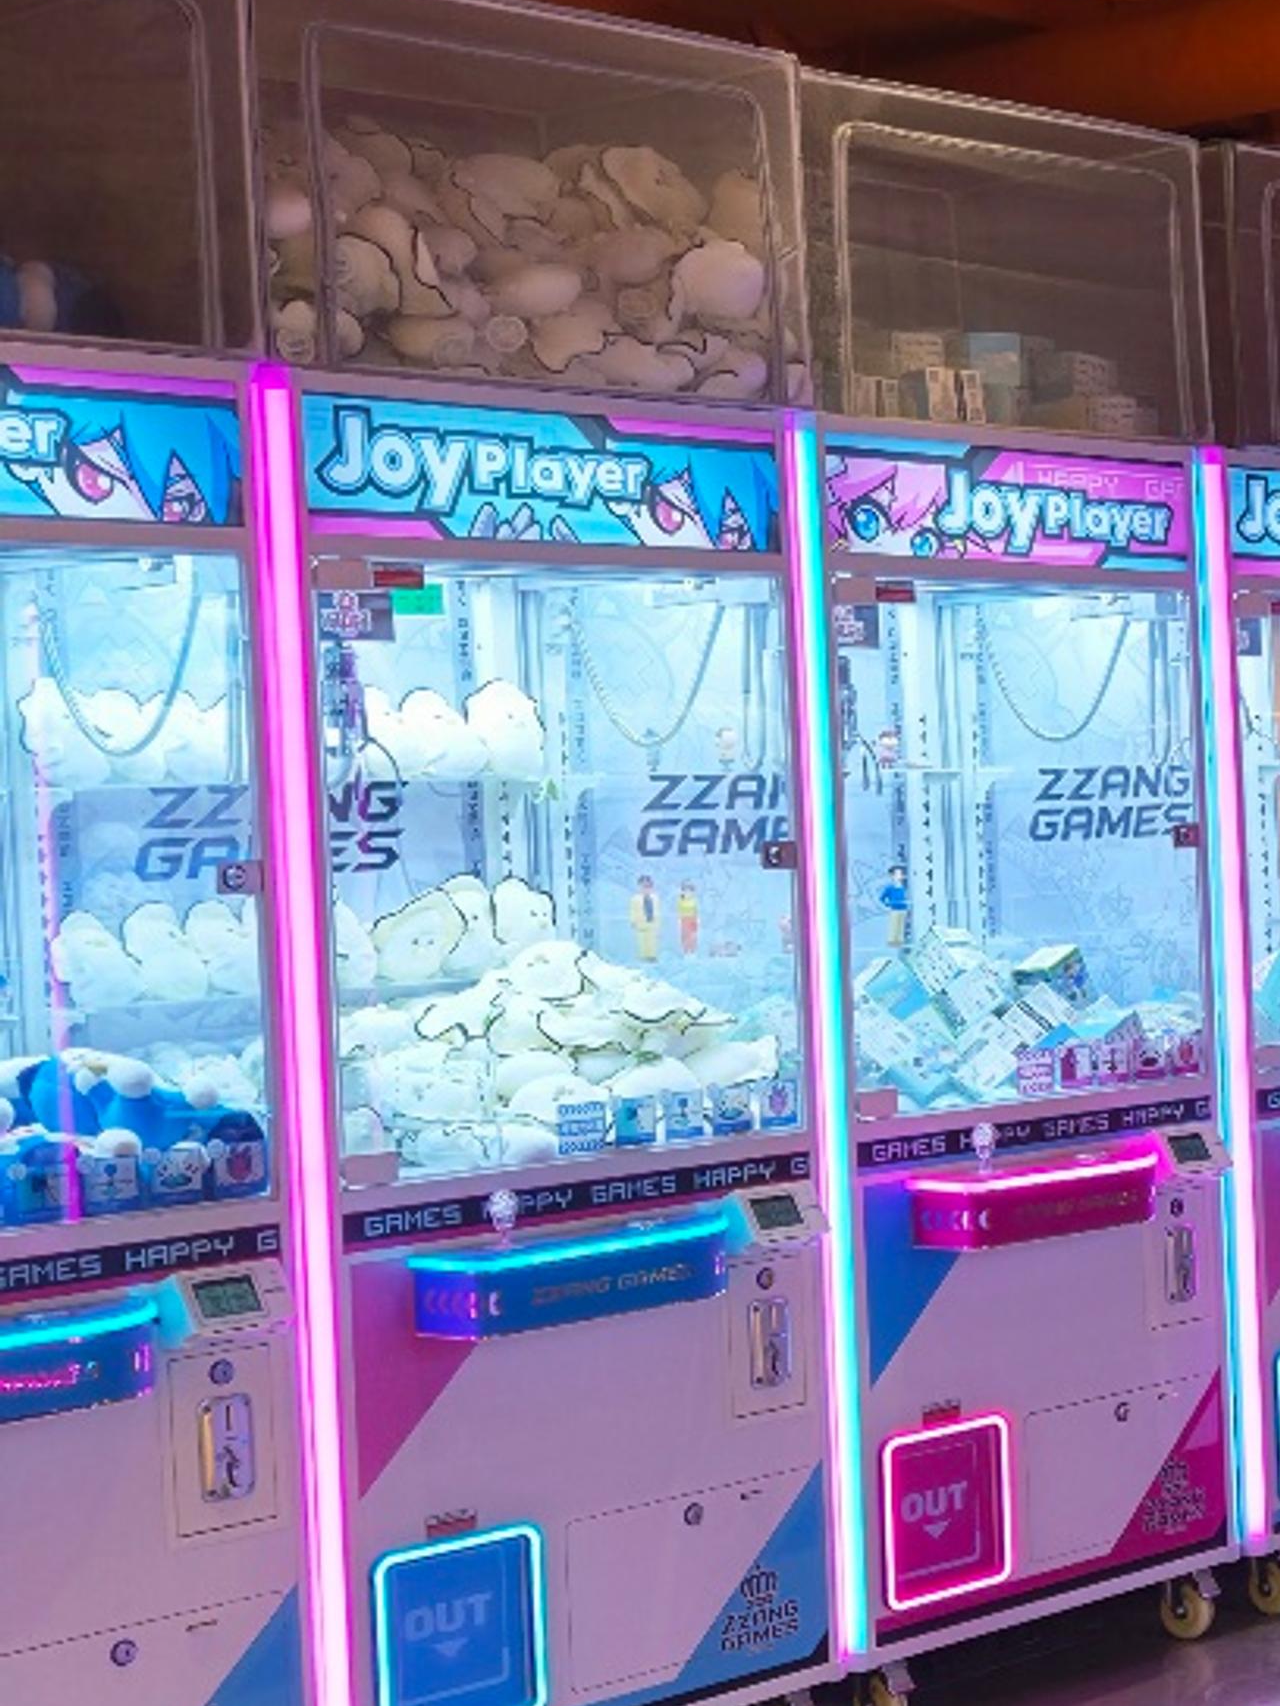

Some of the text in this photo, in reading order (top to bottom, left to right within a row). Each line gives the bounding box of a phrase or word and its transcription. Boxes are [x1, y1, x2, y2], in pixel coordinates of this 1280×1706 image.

[1034, 765, 1191, 802] ZZANG
[1029, 803, 1193, 842] GAMES
[363, 1204, 462, 1238] GAMES
[592, 1176, 678, 1204] GAMES
[694, 1163, 776, 1189] HAPPY
[126, 1235, 234, 1272] HAPPY
[901, 1481, 968, 1523] OUT
[404, 1590, 494, 1641] OUT
